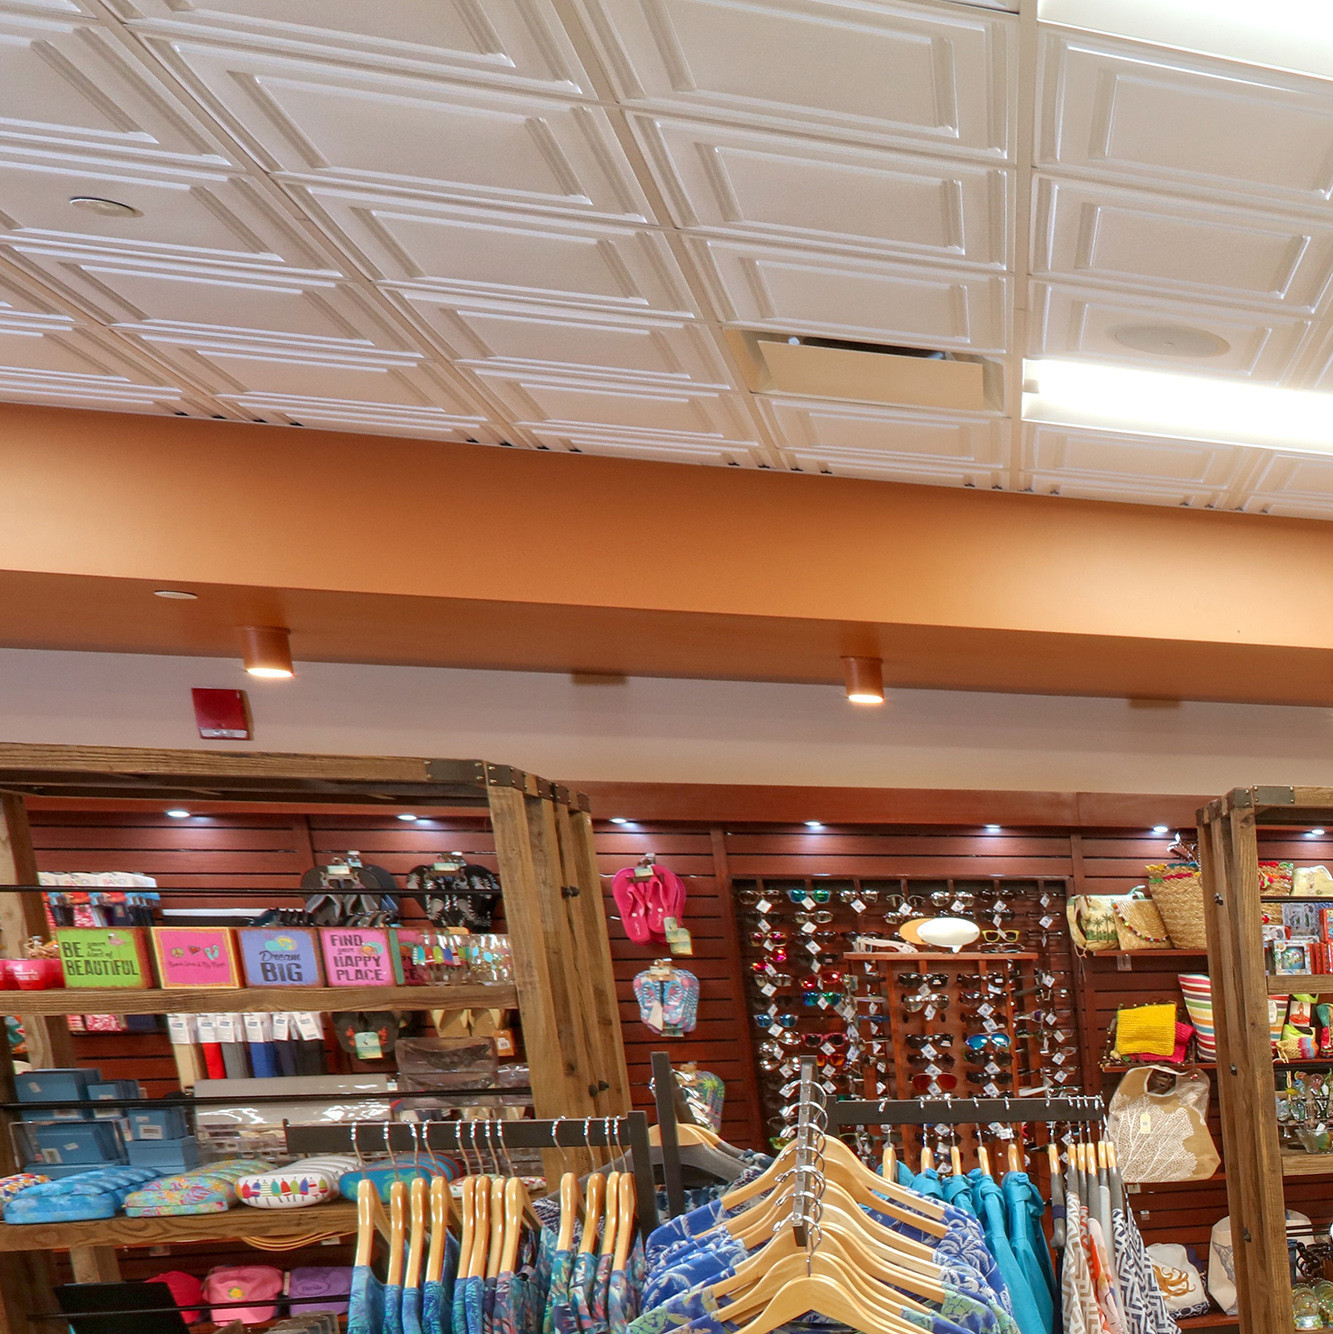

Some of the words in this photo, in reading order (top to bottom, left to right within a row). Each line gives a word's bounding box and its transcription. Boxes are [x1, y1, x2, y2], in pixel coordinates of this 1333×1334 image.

[330, 934, 363, 946] FIND
[61, 941, 84, 958] BE
[258, 950, 301, 961] Dream
[66, 959, 140, 976] BEAUTIFUL
[333, 955, 381, 968] HAPPY
[260, 962, 303, 982] BIG
[337, 969, 384, 981] PLACE
